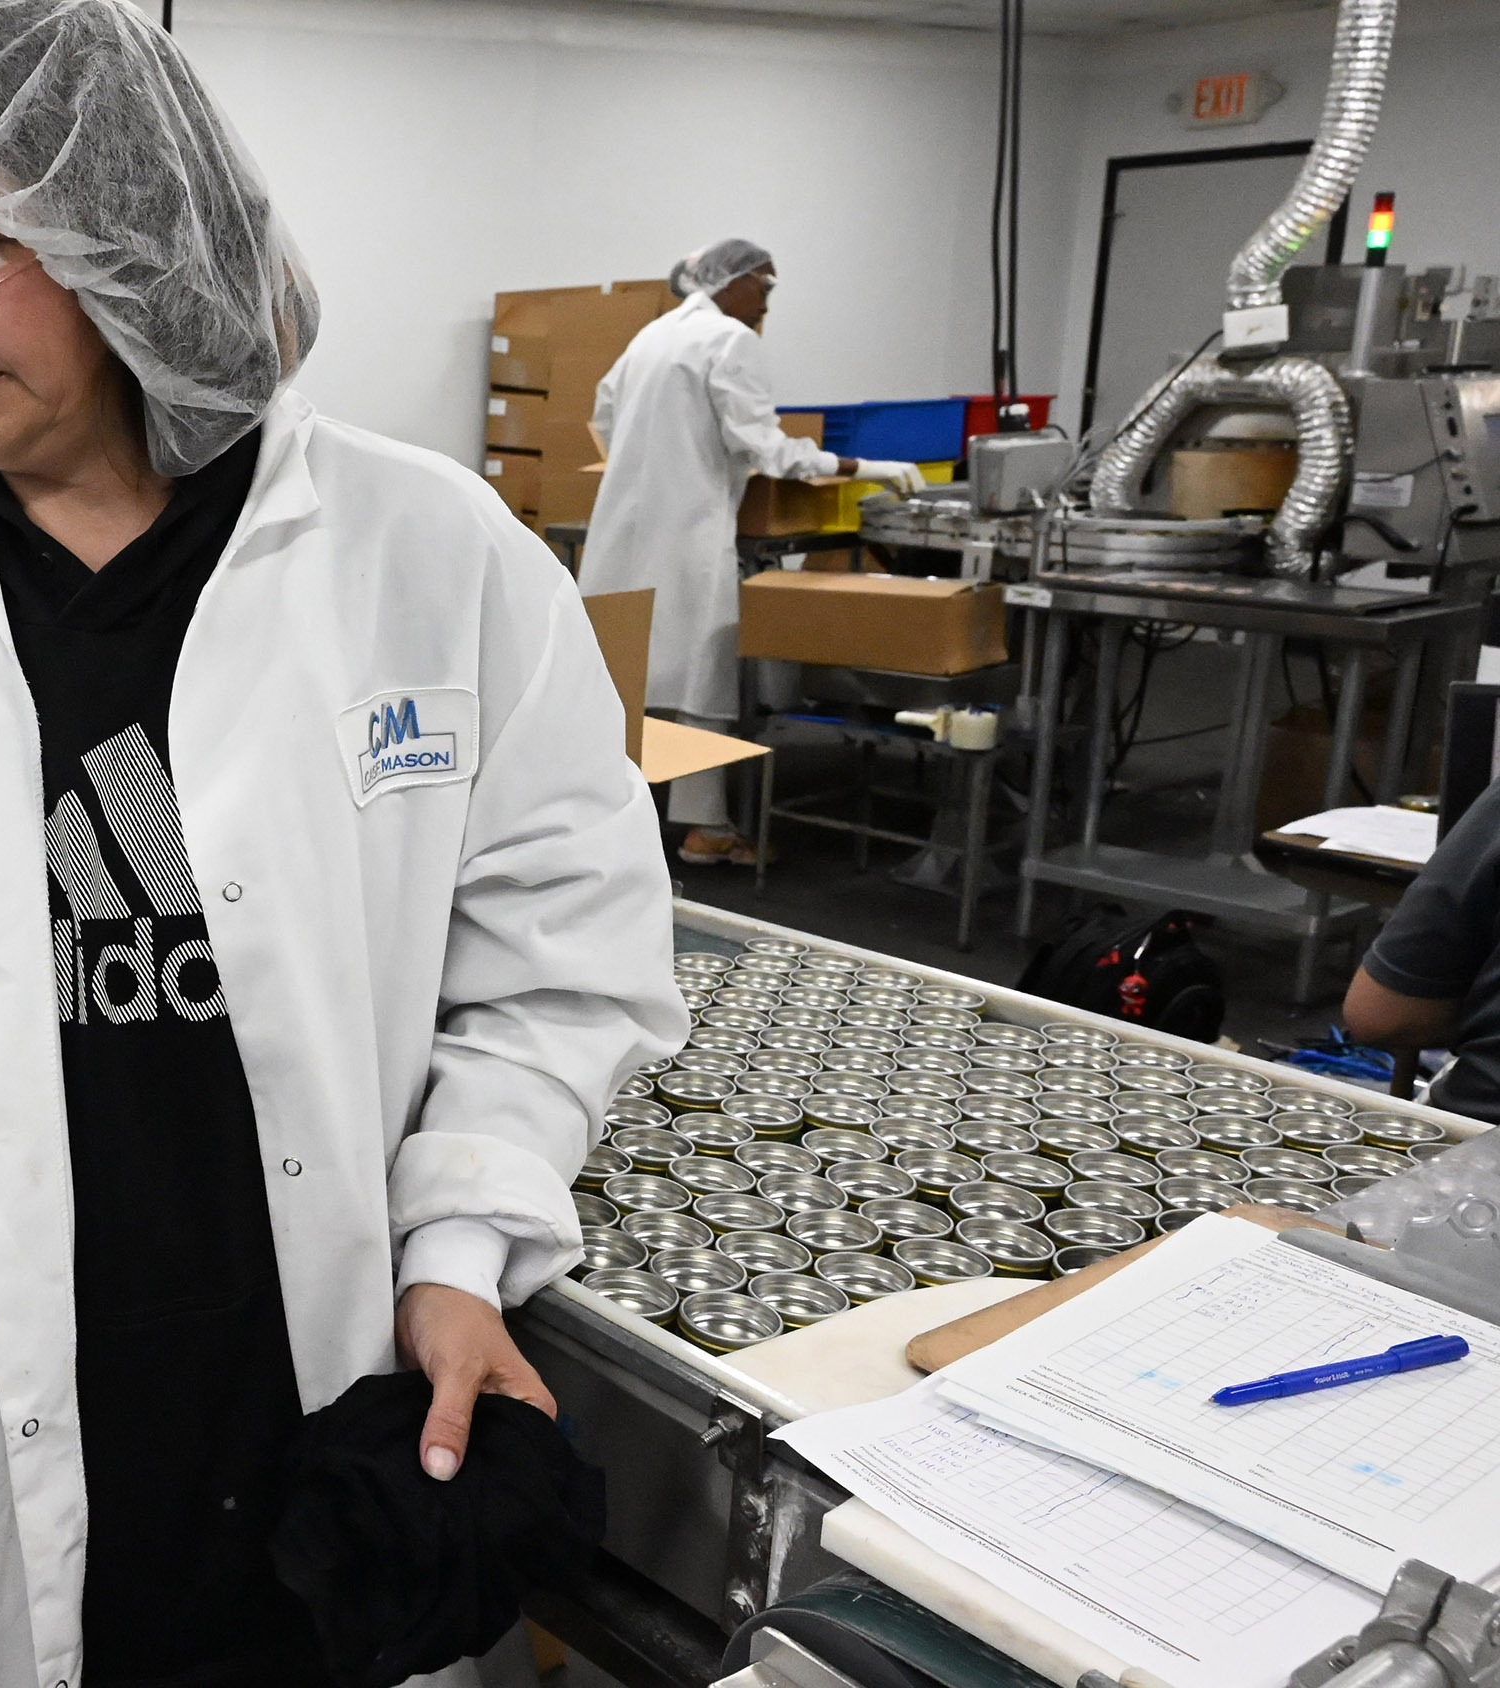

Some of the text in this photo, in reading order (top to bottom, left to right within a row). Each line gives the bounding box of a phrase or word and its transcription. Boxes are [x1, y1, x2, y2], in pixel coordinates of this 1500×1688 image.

[1194, 74, 1249, 118] EXIT
[368, 697, 420, 759] CM
[1005, 1384, 1027, 1396] CHECK
[1028, 1394, 1040, 1402] Rev
[927, 1424, 951, 1439] 1130
[1085, 1402, 1106, 1414] weight
[1136, 1425, 1155, 1435] small
[1155, 1434, 1171, 1443] scale
[1171, 1442, 1195, 1454] weight
[1144, 1440, 1162, 1450] Case
[1318, 1520, 1341, 1532] SPOT
[1342, 1531, 1377, 1549] WEIGHT
